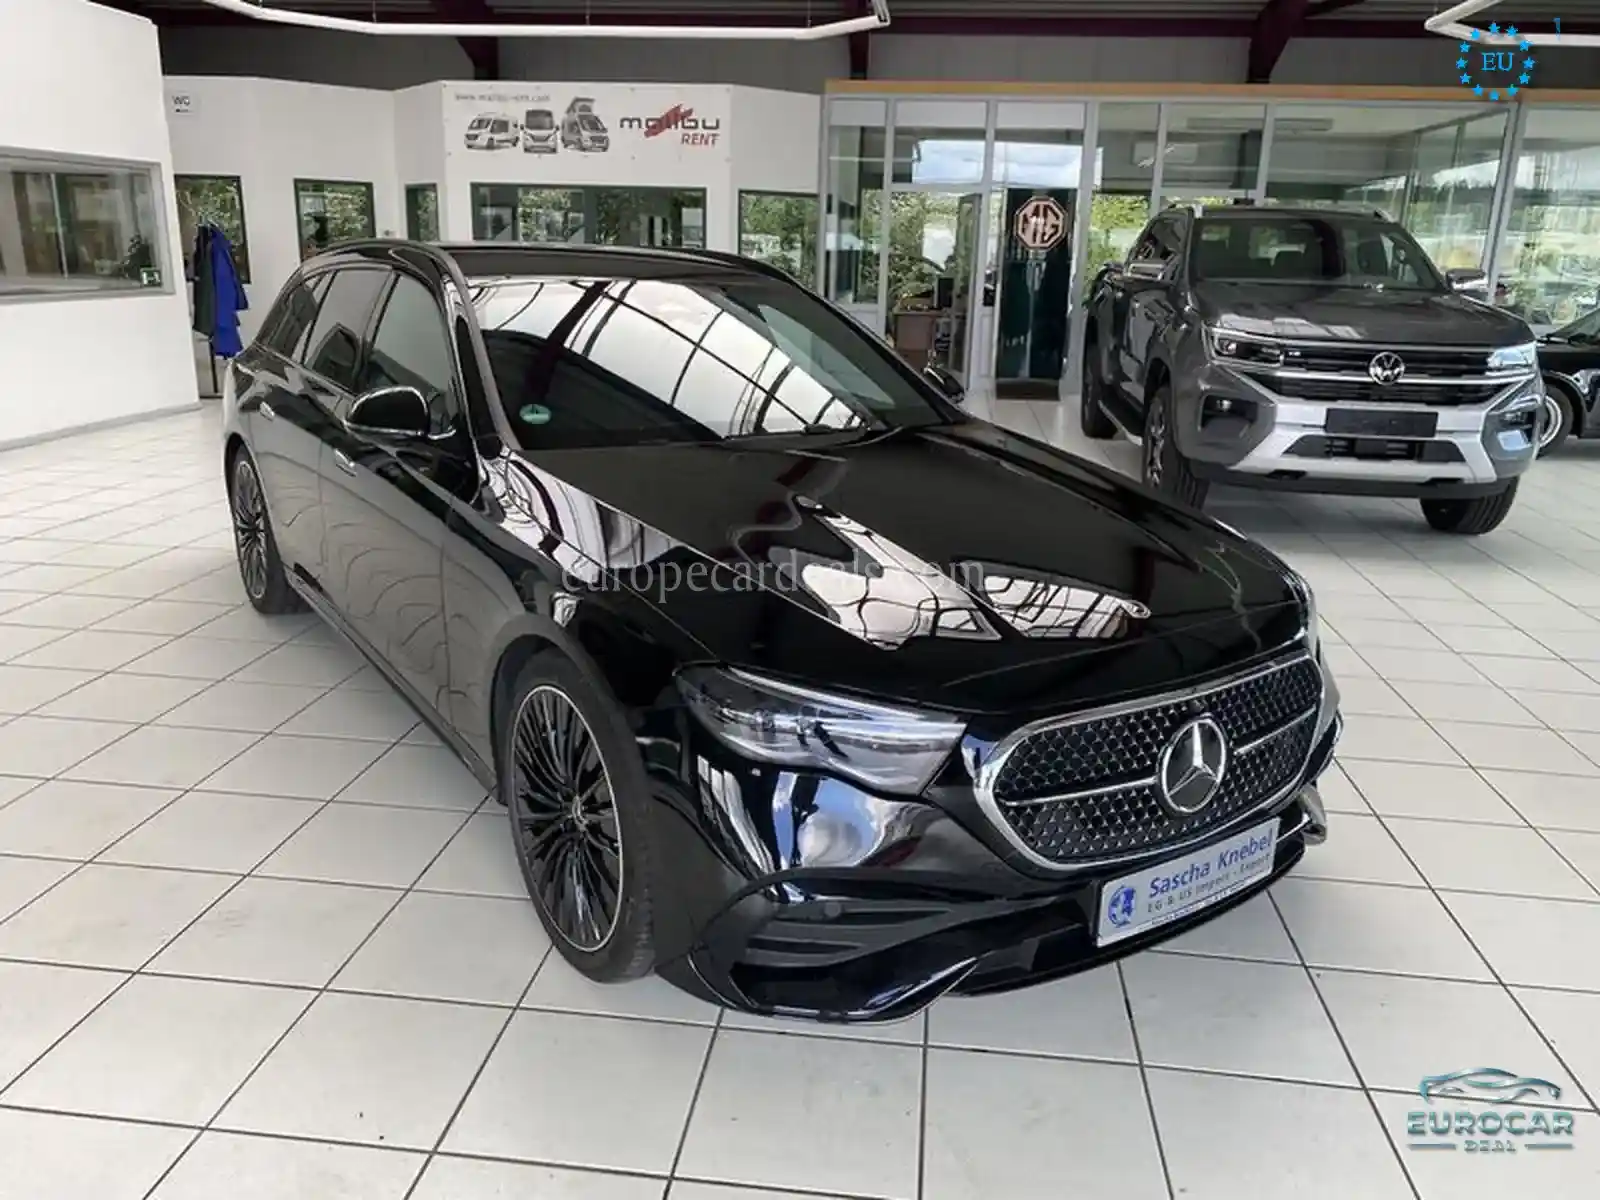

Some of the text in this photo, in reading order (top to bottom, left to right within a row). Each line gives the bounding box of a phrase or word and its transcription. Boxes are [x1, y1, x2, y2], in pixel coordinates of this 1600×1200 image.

[681, 132, 720, 146] RENT
[1149, 827, 1273, 899] Sascha Knebel
